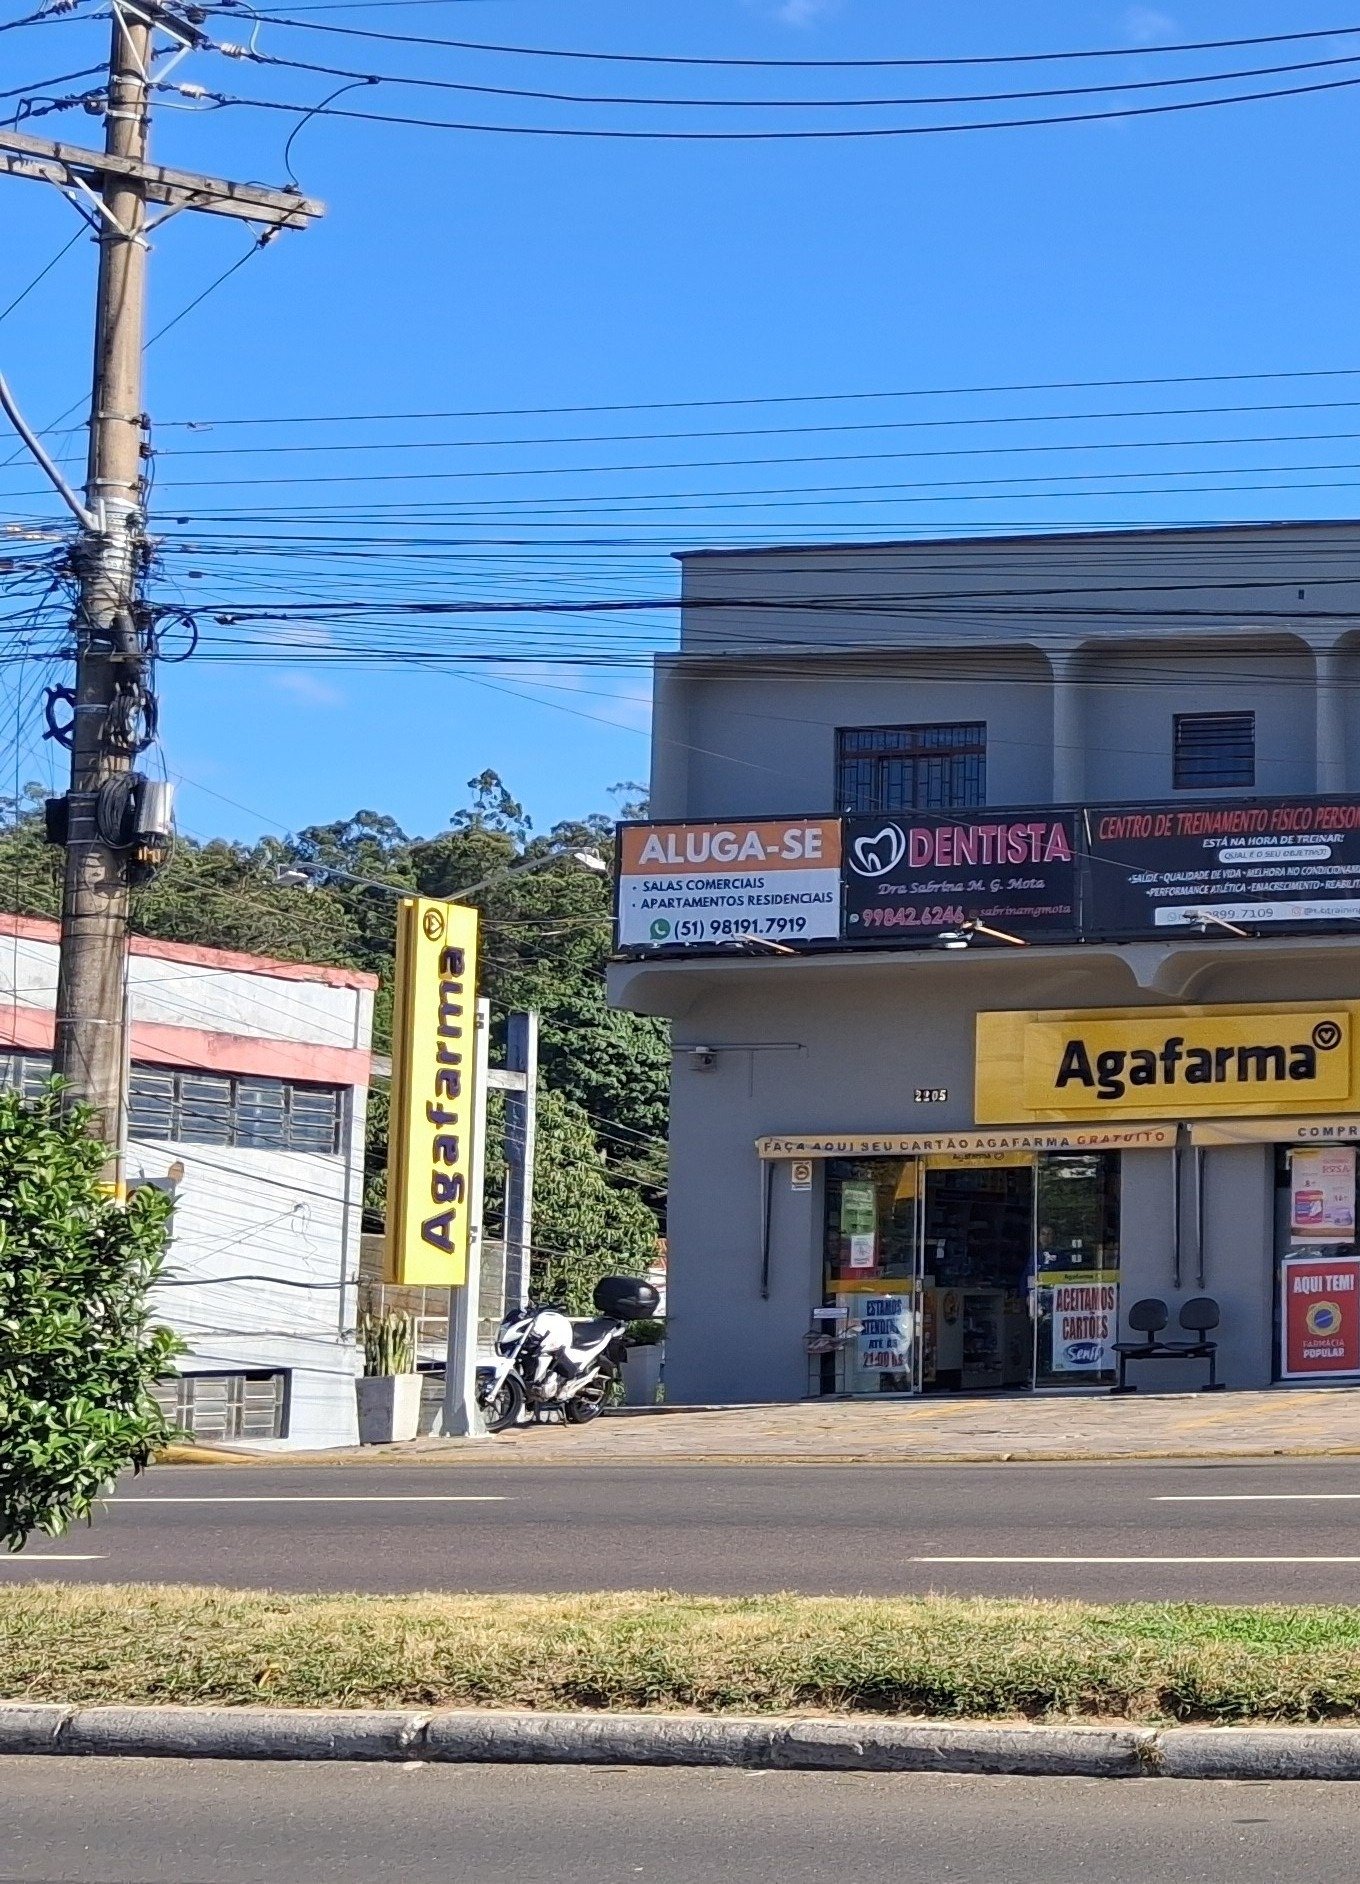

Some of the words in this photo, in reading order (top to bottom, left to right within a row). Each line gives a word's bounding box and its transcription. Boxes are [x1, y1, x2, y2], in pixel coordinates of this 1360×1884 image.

[1100, 814, 1152, 840] CENTRO
[1155, 813, 1174, 837] DE
[1177, 808, 1268, 836] TREINAMENTO
[1271, 803, 1313, 831] FÍSICO
[638, 828, 823, 865] ALUGA-SE
[909, 822, 1071, 868] DENTISTA
[1202, 835, 1228, 848] ESTÁ
[1230, 838, 1245, 847] NA
[1247, 835, 1278, 846] HORA
[1280, 835, 1295, 844] DE
[643, 880, 683, 892] SALAS
[686, 877, 765, 891] COMERCIAIS
[1163, 870, 1210, 884] QUALIDADE
[1211, 869, 1222, 879] DE
[1222, 868, 1241, 879] VIDA
[1246, 867, 1286, 879] MELHORA
[1287, 866, 1300, 876] NO
[878, 883, 907, 895] Dra
[909, 880, 964, 894] Sabrina
[1006, 878, 1045, 890] Mota
[1149, 885, 1209, 897] PERFORMANCE
[1210, 882, 1246, 894] ATLÉTICA
[641, 895, 745, 909] APARTAMENTOS
[748, 892, 834, 906] RESIDENCIAIS
[862, 905, 965, 927] 99842.6246
[674, 919, 705, 940] (51)
[710, 916, 807, 936] 98191.7919
[1054, 1036, 1319, 1100] Agafarma
[421, 944, 467, 1256] Agafarma
[764, 1141, 806, 1154] FAÇA
[811, 1142, 854, 1152] AQUI
[860, 1141, 893, 1152] SEU
[900, 1138, 969, 1151] CARTÃO
[975, 1137, 1071, 1149] AGAFARMA
[1076, 1131, 1166, 1145] GRATUITO
[1293, 1274, 1323, 1294] AQUI
[1325, 1273, 1355, 1292] TEM!
[1055, 1286, 1115, 1312] ACEITAMOS
[1062, 1311, 1109, 1341] CARTÕES
[1303, 1347, 1345, 1359] POPULAR
